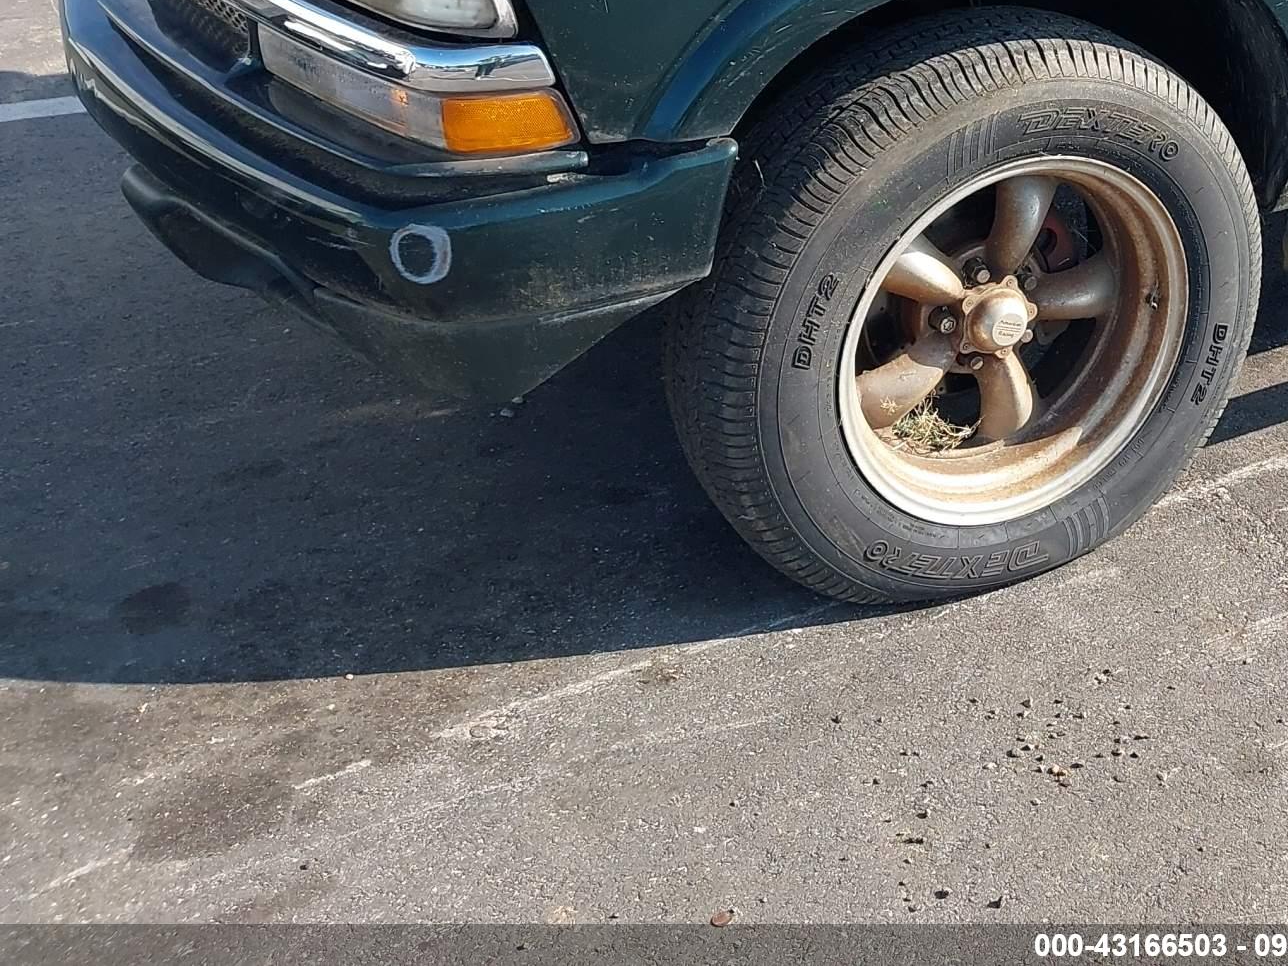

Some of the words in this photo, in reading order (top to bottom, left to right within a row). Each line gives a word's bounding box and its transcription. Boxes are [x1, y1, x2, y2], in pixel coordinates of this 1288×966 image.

[1017, 106, 1180, 161] DEXTERO
[791, 273, 840, 371] DHT2
[1190, 322, 1230, 406] DHT2
[863, 539, 1049, 580] DEXTERO
